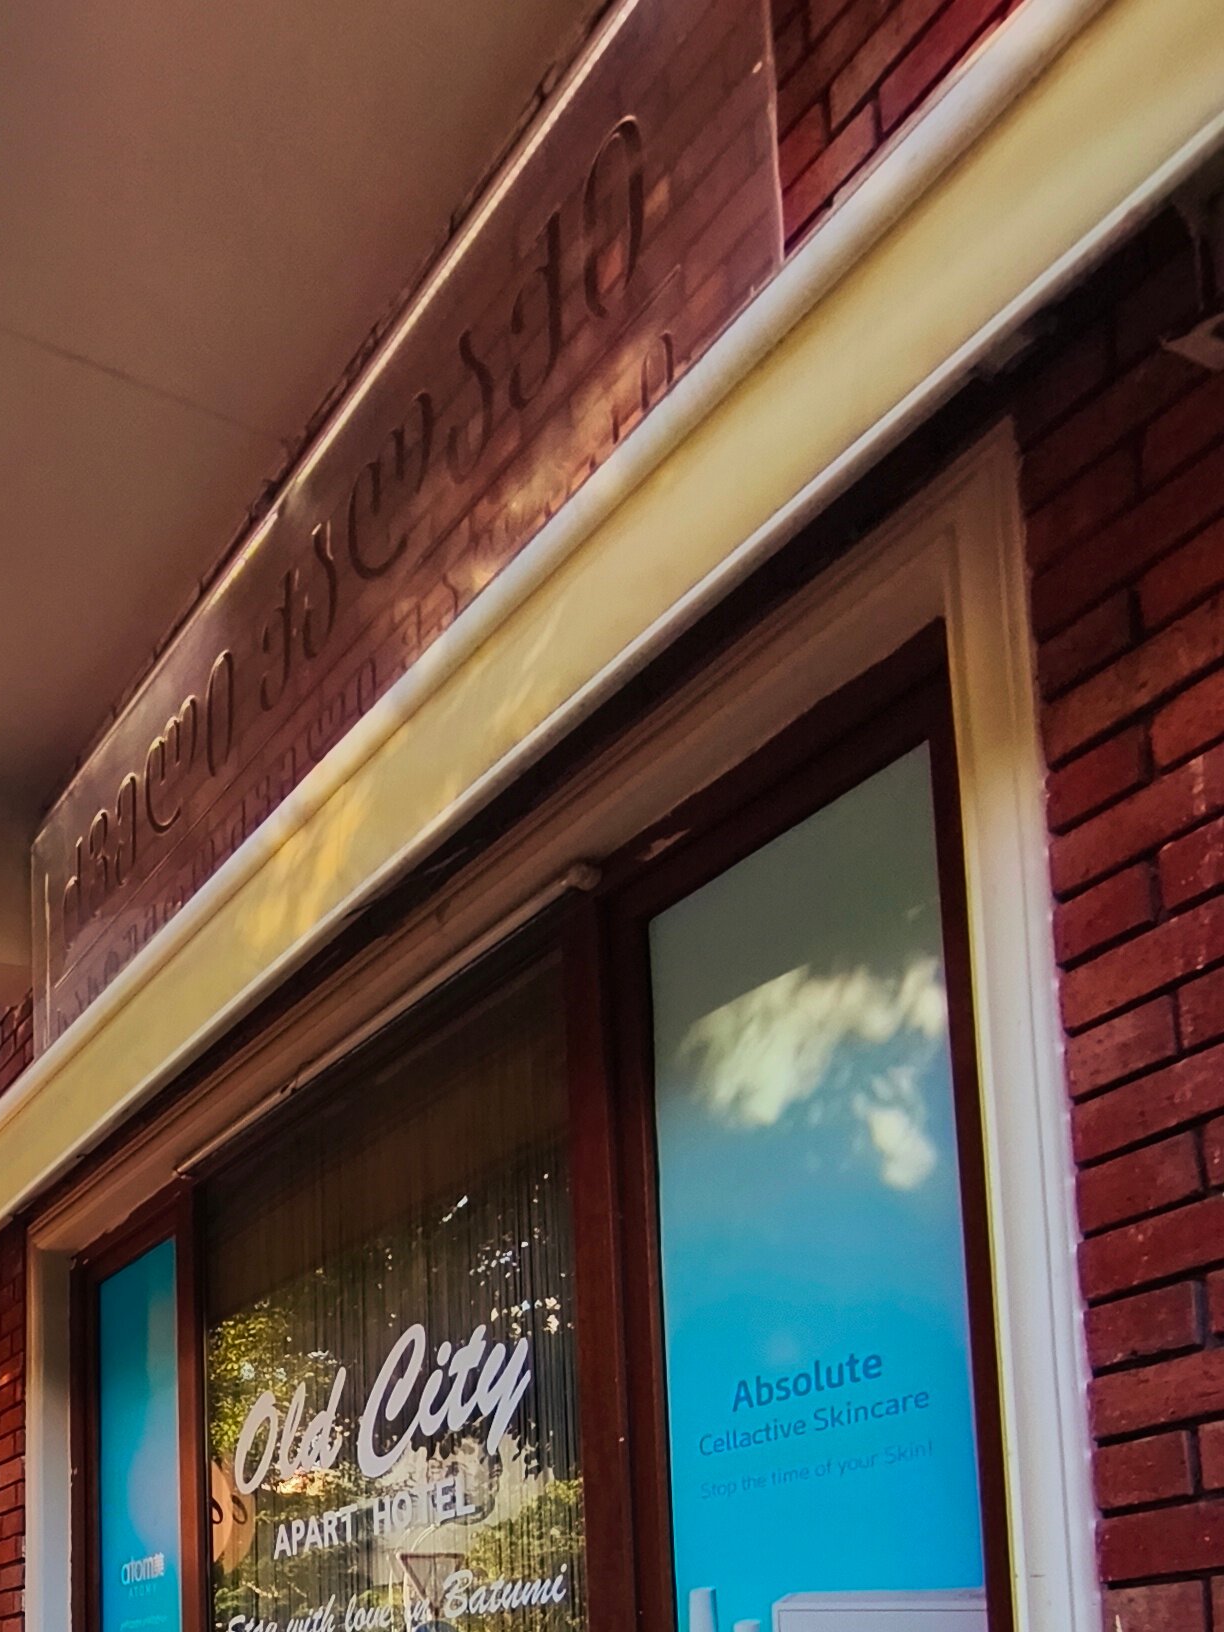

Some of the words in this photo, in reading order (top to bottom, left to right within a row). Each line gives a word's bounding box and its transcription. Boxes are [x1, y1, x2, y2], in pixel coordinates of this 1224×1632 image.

[234, 1366, 347, 1495] Old
[357, 1323, 531, 1479] City
[732, 1352, 883, 1413] Absolute
[699, 1418, 807, 1457] Cellactive
[813, 1390, 930, 1432] Skincare
[700, 1480, 737, 1500] Stop
[741, 1474, 767, 1492] the
[771, 1466, 810, 1486] time
[815, 1459, 833, 1478] of
[837, 1453, 878, 1477] your
[273, 1504, 358, 1560] APART
[373, 1474, 476, 1537] HOTEL
[344, 1596, 395, 1632] love
[442, 1563, 568, 1619] Batumi
